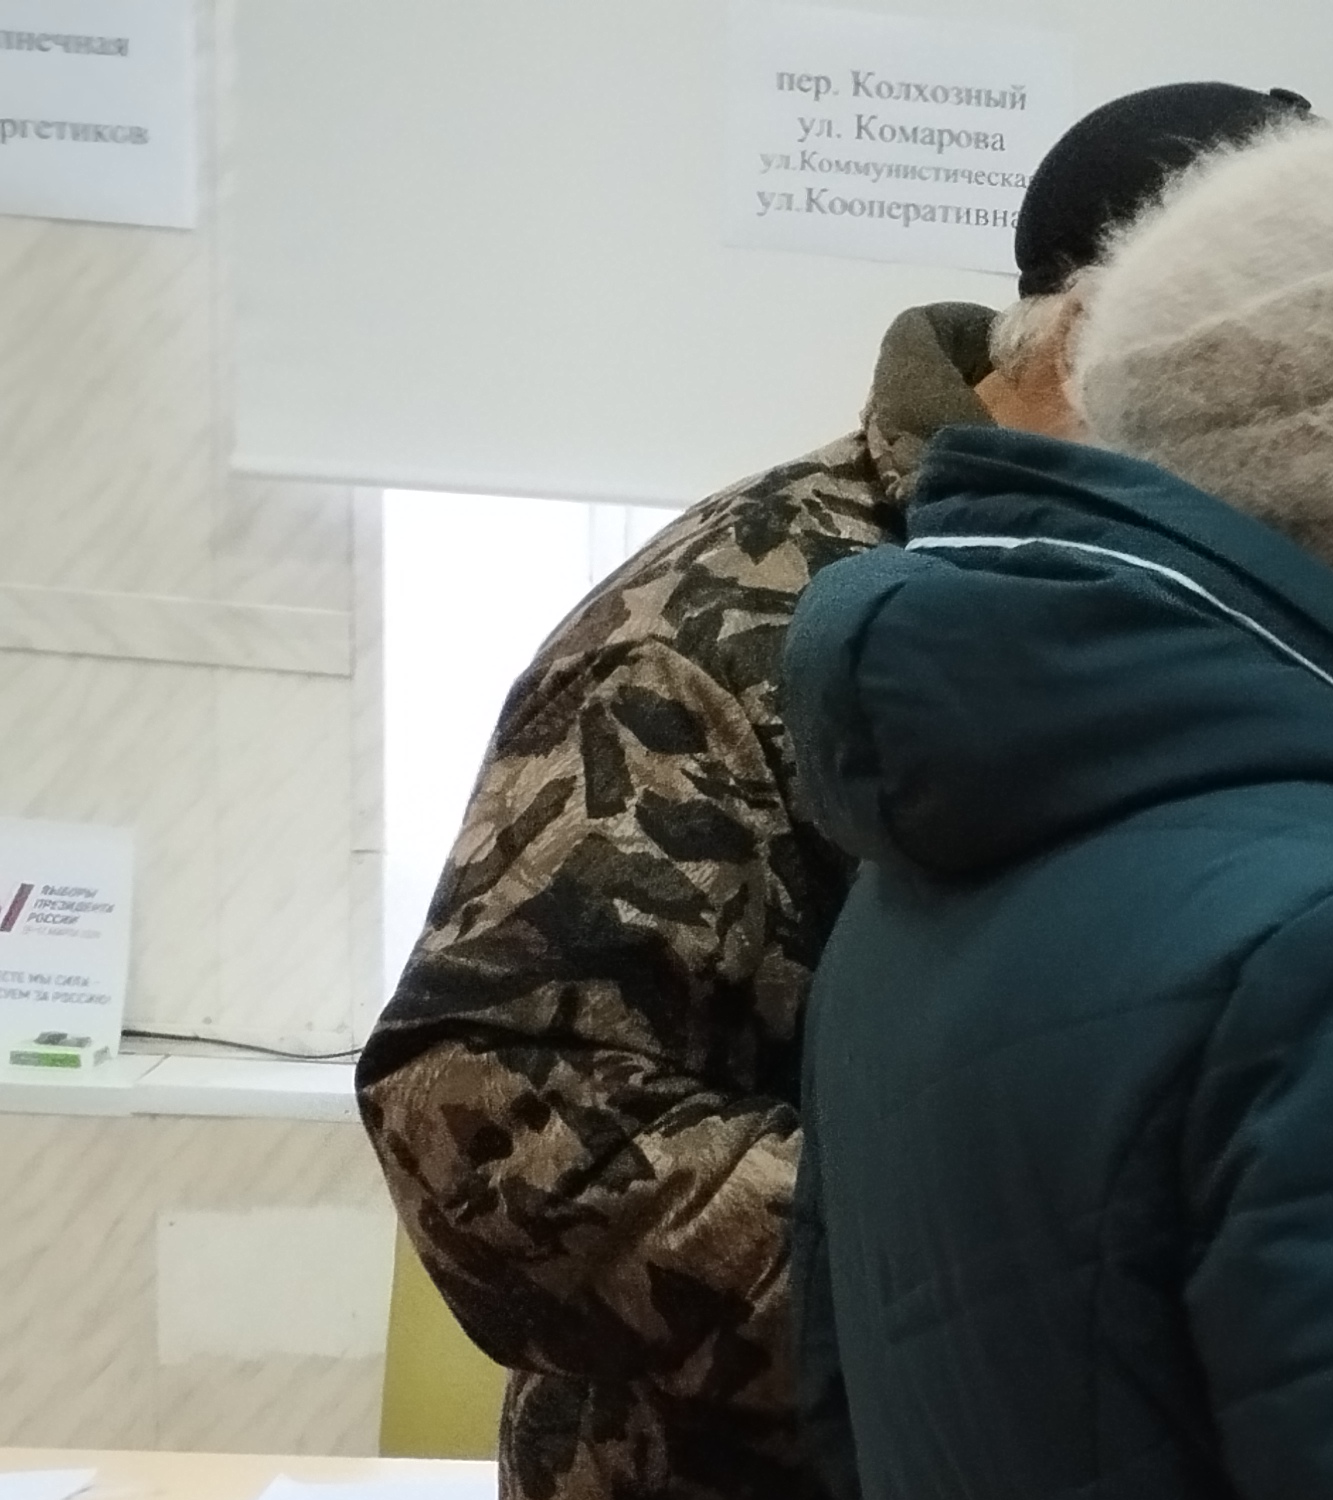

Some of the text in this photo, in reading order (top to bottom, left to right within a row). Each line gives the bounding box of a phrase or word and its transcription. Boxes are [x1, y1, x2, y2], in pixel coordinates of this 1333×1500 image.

[776, 69, 1027, 111] пер. Колхозный
[797, 113, 1006, 154] ул. Комарова
[759, 150, 1034, 189] ул.Коммунистическа
[756, 187, 1019, 228] ул.Кооперативна
